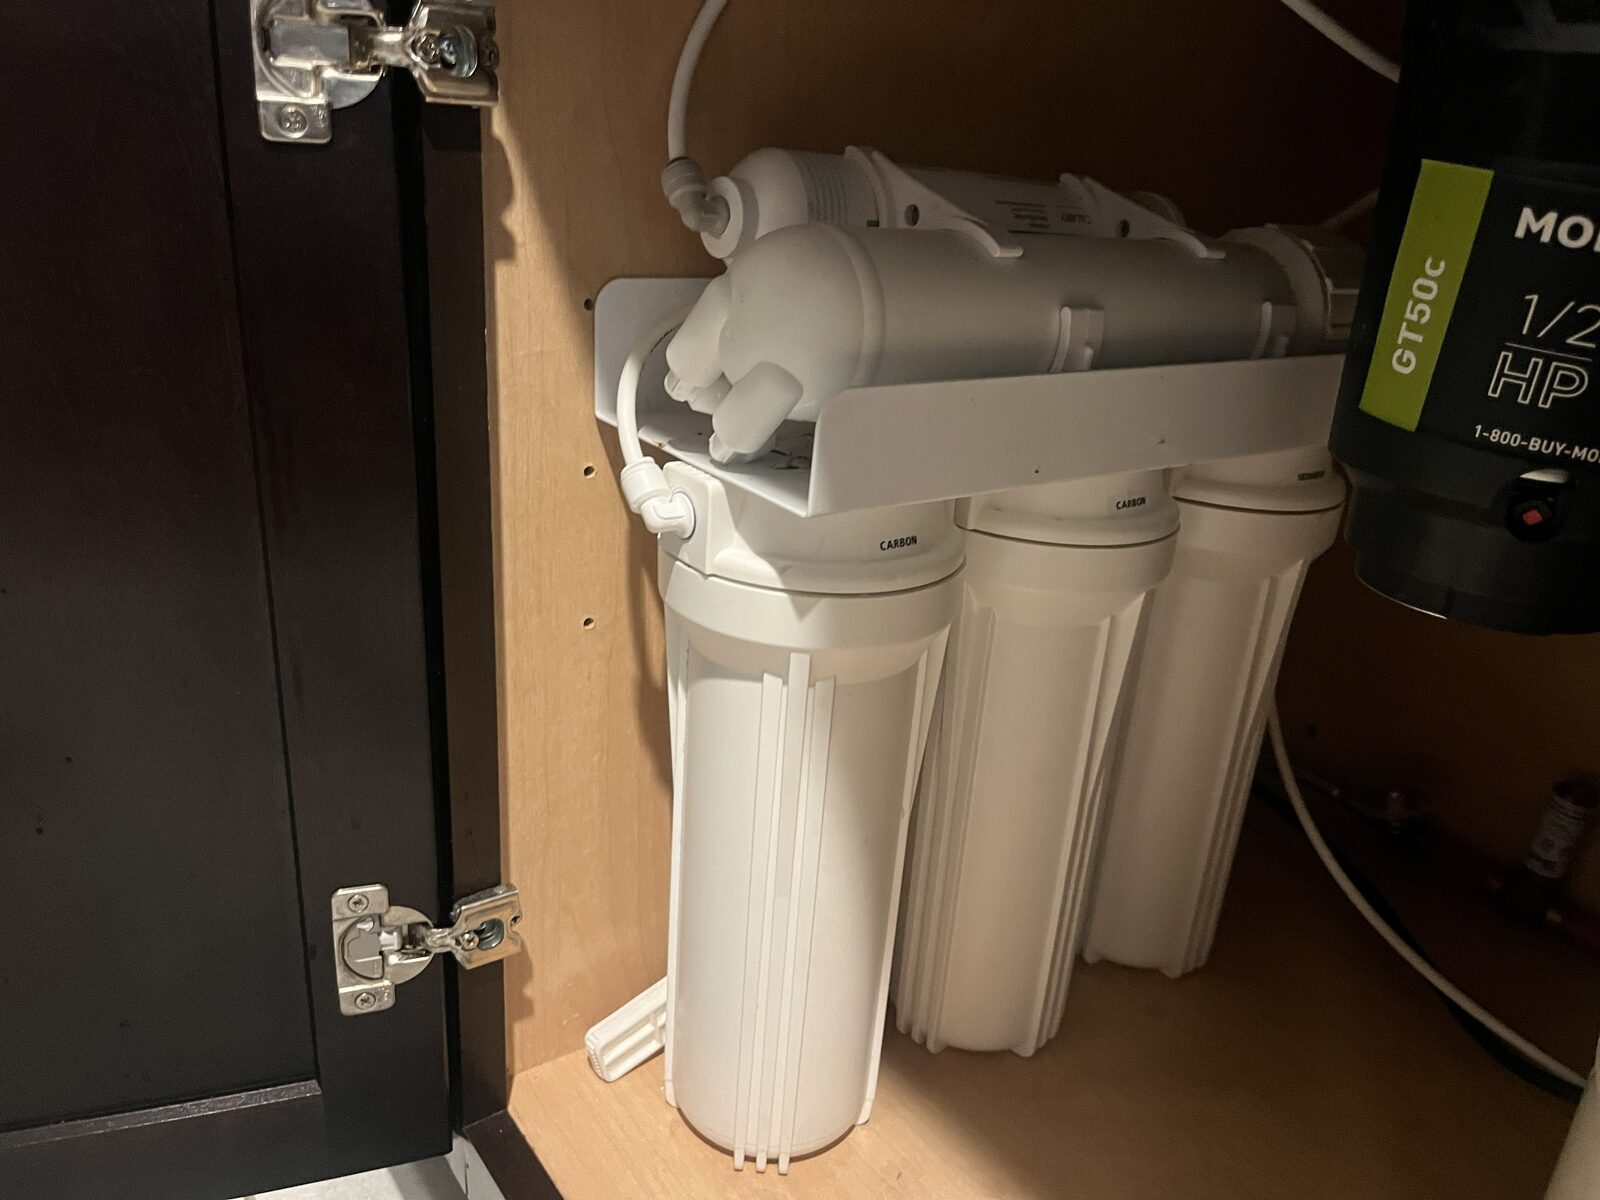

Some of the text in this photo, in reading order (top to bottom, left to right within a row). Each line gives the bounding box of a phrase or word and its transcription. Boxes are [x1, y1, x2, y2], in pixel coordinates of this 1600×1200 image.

[1515, 206, 1600, 252] MO
[1391, 255, 1446, 375] GT50c
[1522, 294, 1600, 348] 1/2
[1487, 351, 1588, 409] HP
[1474, 424, 1600, 464] 1-800-BUY-MO
[1116, 496, 1147, 510] CARBON
[880, 535, 918, 551] CARBON
